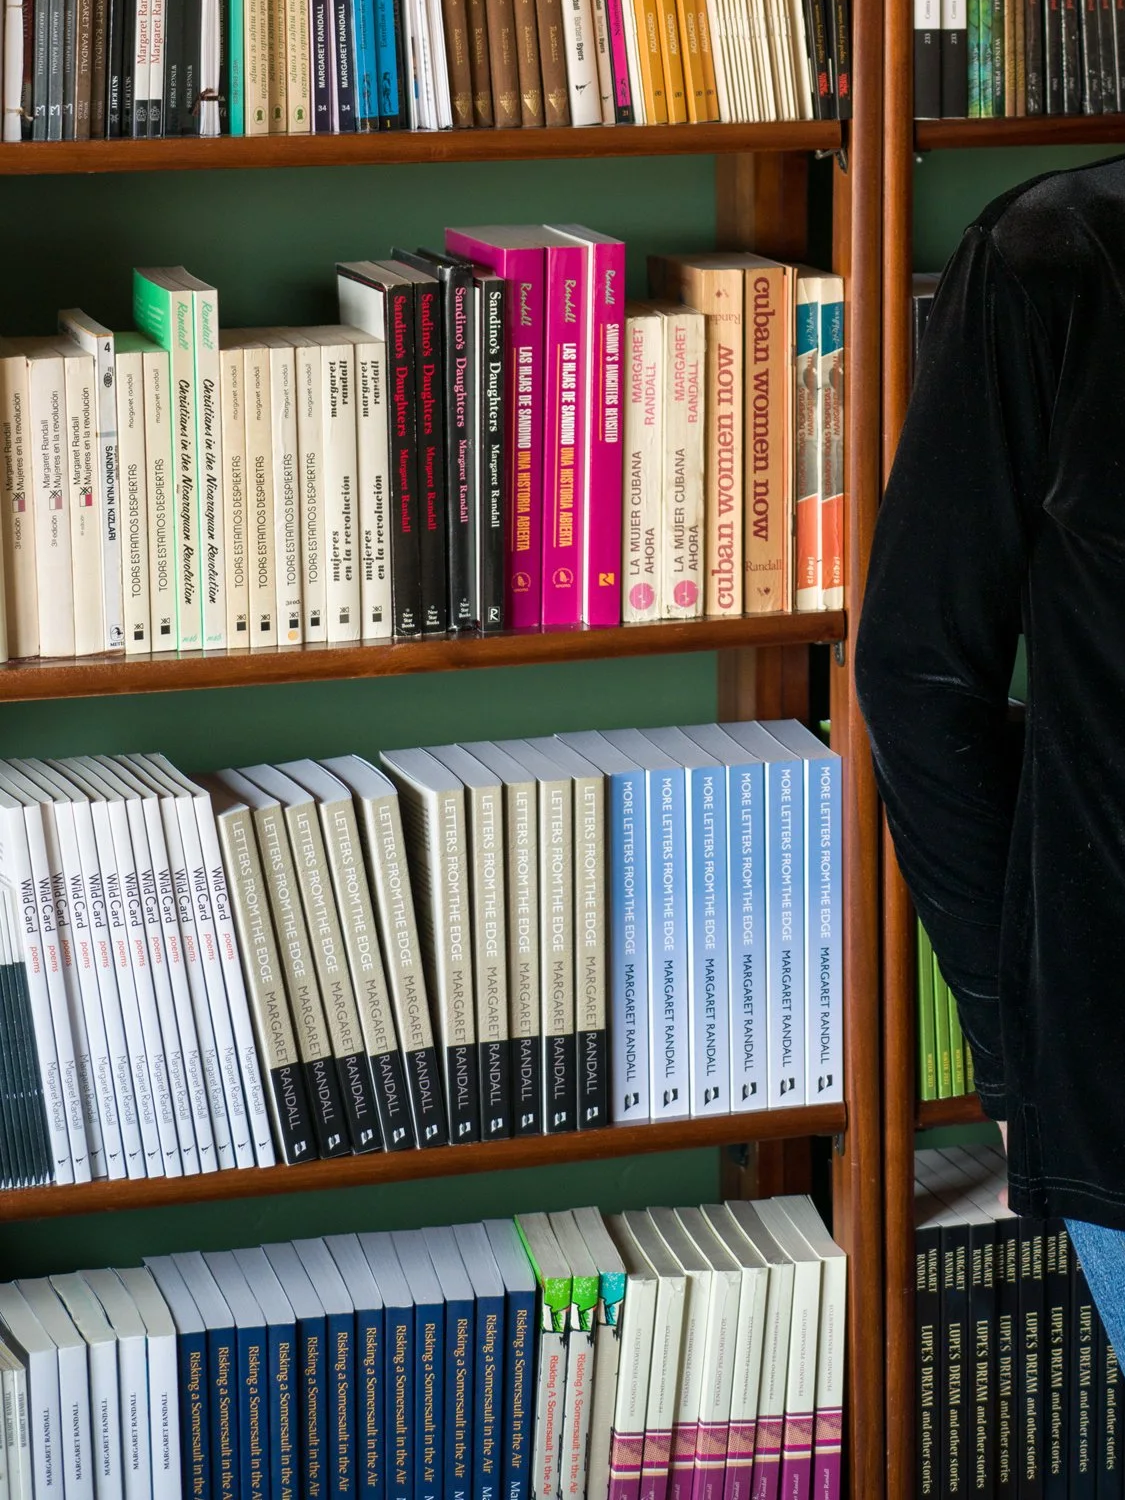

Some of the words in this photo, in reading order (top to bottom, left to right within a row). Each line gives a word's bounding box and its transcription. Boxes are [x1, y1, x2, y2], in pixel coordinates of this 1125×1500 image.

[137, 19, 148, 65] Margaret
[316, 4, 325, 42] RANDALL
[80, 32, 89, 74] RANDALL
[318, 44, 326, 89] MARGARET
[565, 279, 576, 322] Randall
[605, 270, 615, 304] Randall
[177, 299, 188, 350] Randall
[489, 291, 502, 354] Sandino's
[754, 277, 775, 364] cuban
[104, 341, 110, 352] 4
[519, 346, 533, 364] LAS
[606, 323, 620, 362] SANDINO'S
[339, 360, 348, 405] randall
[518, 365, 532, 393] HIJAS
[605, 363, 619, 405] DAUGHTERS
[632, 326, 644, 405] MARGARET
[717, 343, 734, 407] now
[83, 387, 91, 429] revolución
[178, 379, 190, 437] Christians
[329, 361, 338, 418] margaret
[488, 362, 501, 432] Daughters
[518, 394, 532, 407] DE
[643, 361, 657, 428] RANDALL
[72, 416, 80, 447] Randall
[83, 430, 90, 439] la
[517, 408, 532, 449] SANDINO
[604, 407, 618, 443] REVISITED
[753, 369, 769, 474] women
[84, 439, 91, 450] en
[180, 439, 191, 451] in
[181, 453, 191, 471] the
[517, 450, 531, 470] UNA
[73, 449, 81, 486] Margaret
[84, 451, 93, 488] Mujeres
[104, 445, 114, 505] SANDINO'NUN
[490, 444, 500, 485] Margaret
[631, 451, 641, 506] CUBANA
[717, 413, 734, 517] women
[128, 463, 138, 517] DESPIERTAS
[182, 474, 193, 541] Nicaraguan
[491, 490, 500, 527] Randall
[517, 472, 531, 513] HISTORIA
[106, 508, 116, 542] KIZLARI
[342, 476, 351, 545] revolución
[753, 479, 769, 541] now
[129, 518, 140, 567] ESTAMOS
[516, 515, 530, 552] ABIERTA
[630, 510, 641, 552] MUJER
[333, 531, 342, 581] mujeres
[343, 549, 352, 561] la
[629, 558, 640, 576] LA
[644, 528, 655, 574] AHORA
[711, 522, 735, 609] cuban
[745, 559, 783, 572] Randall
[131, 569, 140, 599] TODAS
[183, 544, 195, 605] Revolution
[345, 566, 352, 581] en
[820, 766, 831, 799] MORE
[820, 801, 831, 848] LETTERS
[232, 821, 251, 875] LETTERS
[820, 850, 831, 881] FROM
[213, 866, 225, 892] Wild
[243, 877, 260, 915] FROM
[820, 883, 831, 906] THE
[216, 893, 230, 921] Card
[820, 908, 831, 939] EDGE
[221, 931, 234, 961] poems
[250, 917, 266, 947] THE
[255, 949, 273, 984] EDGE
[820, 947, 830, 1007] MARGARET
[820, 1011, 830, 1064] RANDALL
[265, 991, 288, 1063] MARGARET
[279, 1067, 301, 1131] RANDALL
[244, 1046, 257, 1084] Margaret
[252, 1085, 264, 1116] Randall
[916, 1253, 925, 1291] RANDALL
[928, 1248, 937, 1293] MARGARET
[513, 1308, 527, 1348] Risking
[921, 1324, 933, 1363] LUPE'S
[513, 1359, 525, 1418] Somersault
[920, 1366, 933, 1406] DREAM
[160, 1391, 168, 1429] RANDALL
[512, 1419, 523, 1430] in
[921, 1409, 932, 1430] and
[162, 1430, 170, 1469] MARGARET
[512, 1433, 523, 1450] the
[512, 1452, 522, 1468] Air
[921, 1431, 932, 1458] other
[921, 1460, 933, 1494] stories
